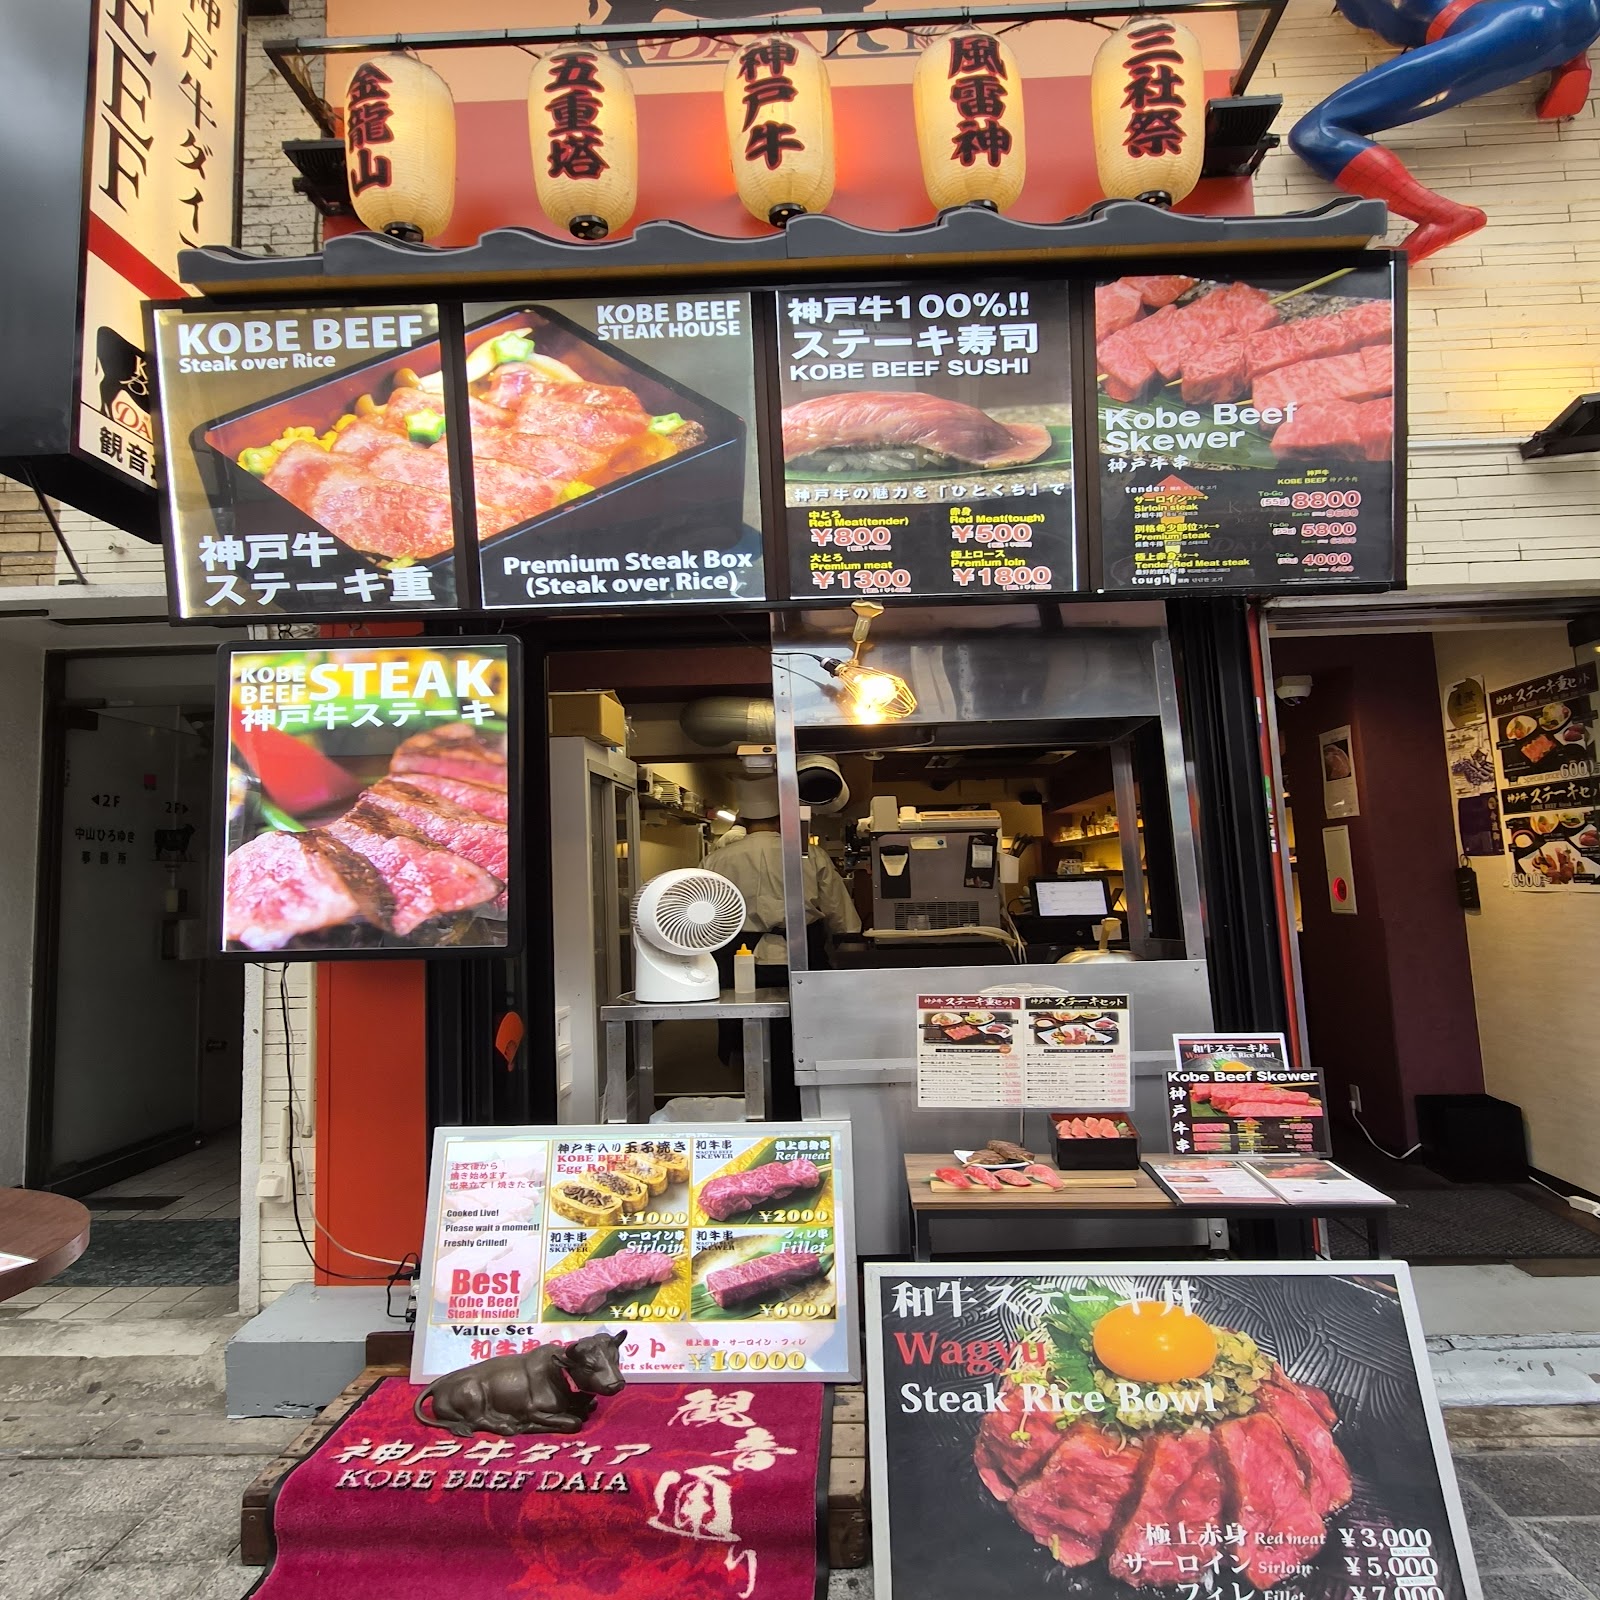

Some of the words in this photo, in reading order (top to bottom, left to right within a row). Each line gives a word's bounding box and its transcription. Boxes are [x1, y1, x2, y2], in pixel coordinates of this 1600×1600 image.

[1120, 22, 1187, 158] 三社祭
[737, 38, 805, 170] 神戸牛
[949, 35, 1013, 167] 風雷神
[543, 51, 610, 180] 五重塔
[346, 63, 395, 197] 金龍山
[596, 303, 670, 325] KOBE
[675, 300, 741, 322] BEEF
[177, 319, 301, 357] KOBE
[312, 315, 424, 351] BEEF
[597, 322, 664, 341] STEAK
[668, 320, 741, 338] HOUSE
[791, 322, 1039, 360] ステーキ寿司
[179, 356, 238, 374] Steak
[240, 357, 288, 370] over
[292, 353, 336, 368] Rice
[790, 362, 865, 381] KOBE
[872, 360, 940, 378] BEEF
[947, 357, 1029, 376] SUSHI
[1105, 408, 1201, 431] Kobe
[1213, 401, 1298, 426] Beef
[1106, 430, 1246, 453] Skewer
[1107, 455, 1188, 473] 神戸牛串
[794, 483, 1065, 502] 神戸牛の魅力を「ひとくち」で
[1125, 485, 1165, 493] tender
[1170, 503, 1198, 511] steak
[1291, 490, 1361, 509] 8800
[808, 510, 842, 519] 中とろ
[949, 514, 974, 524] Red
[979, 513, 1045, 524] Meat(tough)
[950, 506, 972, 516] 赤身
[808, 518, 833, 528] Red
[840, 517, 909, 527] Meat(tender)
[1301, 522, 1357, 537] 5800
[811, 527, 891, 547] ¥800
[951, 523, 1032, 543] ¥500
[1135, 533, 1180, 541] Premium
[1182, 531, 1211, 539] steak
[199, 531, 338, 572] 神戸牛
[810, 553, 843, 563] 大とろ
[1301, 552, 1352, 566] 4000
[503, 556, 620, 576] Premium
[625, 552, 697, 572] Steak
[703, 550, 753, 569] Box
[810, 563, 860, 571] Premium
[864, 561, 893, 570] meat
[950, 559, 1000, 568] Premium
[1004, 558, 1026, 567] loin
[1135, 561, 1171, 569] Tender
[1173, 560, 1193, 568] Red
[1195, 559, 1220, 567] Meat
[1222, 558, 1250, 566] steak
[525, 576, 608, 598] (Steak
[612, 577, 671, 593] over
[677, 571, 739, 592] Rice)
[812, 569, 911, 589] ¥1300
[952, 566, 1052, 586] ¥1800
[1131, 576, 1169, 587] tough
[204, 566, 436, 607] ステーキ重
[241, 665, 306, 684] KOBE
[309, 659, 495, 700] STEAK
[241, 684, 306, 704] BEEF
[240, 700, 495, 732] 神戸牛ステーキ
[103, 794, 120, 808] 2F
[164, 802, 180, 814] 2F
[75, 826, 135, 843] 中山ひろゆき
[1167, 1072, 1209, 1083] Kobe
[1214, 1071, 1252, 1082] Beef
[1256, 1071, 1317, 1082] Skewer
[1168, 1086, 1191, 1153] 神戸牛串
[696, 1140, 732, 1149] 和牛串
[557, 1155, 594, 1163] KOBE
[598, 1154, 631, 1162] BEEF
[775, 1151, 797, 1160] Red
[800, 1151, 831, 1160] meat
[557, 1164, 582, 1174] Egg
[587, 1163, 616, 1172] Roll
[618, 1211, 688, 1226] ¥1000
[759, 1209, 829, 1224] ¥2000
[445, 1224, 474, 1232] Please
[550, 1232, 587, 1242] 和牛串
[696, 1230, 733, 1241] 和牛串
[443, 1239, 474, 1248] Freshly
[476, 1239, 508, 1247] Grilled!
[625, 1241, 684, 1253] Sirloin
[780, 1241, 827, 1254] Fillet
[451, 1269, 521, 1295] Best
[449, 1296, 484, 1308] Kobe
[487, 1296, 519, 1307] Beef
[892, 1280, 1201, 1318] 和牛ステーキ丼
[448, 1309, 479, 1319] Steak
[481, 1308, 519, 1318] Inside!
[610, 1302, 681, 1320] ¥4000
[760, 1303, 832, 1319] ¥6000
[451, 1326, 501, 1336] Value
[507, 1325, 534, 1335] Set
[688, 1350, 807, 1371] ¥10000
[894, 1332, 1047, 1376] Wagyu
[640, 1362, 685, 1370] skewer
[900, 1383, 1009, 1413] Steak
[1022, 1385, 1104, 1413] Rice
[1116, 1382, 1218, 1413] Bowl
[332, 1440, 652, 1466] 神戸牛ダイア
[335, 1470, 434, 1491] KOBE
[443, 1471, 535, 1491] BEEF
[540, 1472, 629, 1492] DAIA
[1144, 1522, 1249, 1547] 極上赤身
[1254, 1532, 1283, 1545] Red
[1289, 1533, 1326, 1545] meat
[1123, 1552, 1251, 1575] サーロイン
[1258, 1561, 1311, 1575] Sirloin
